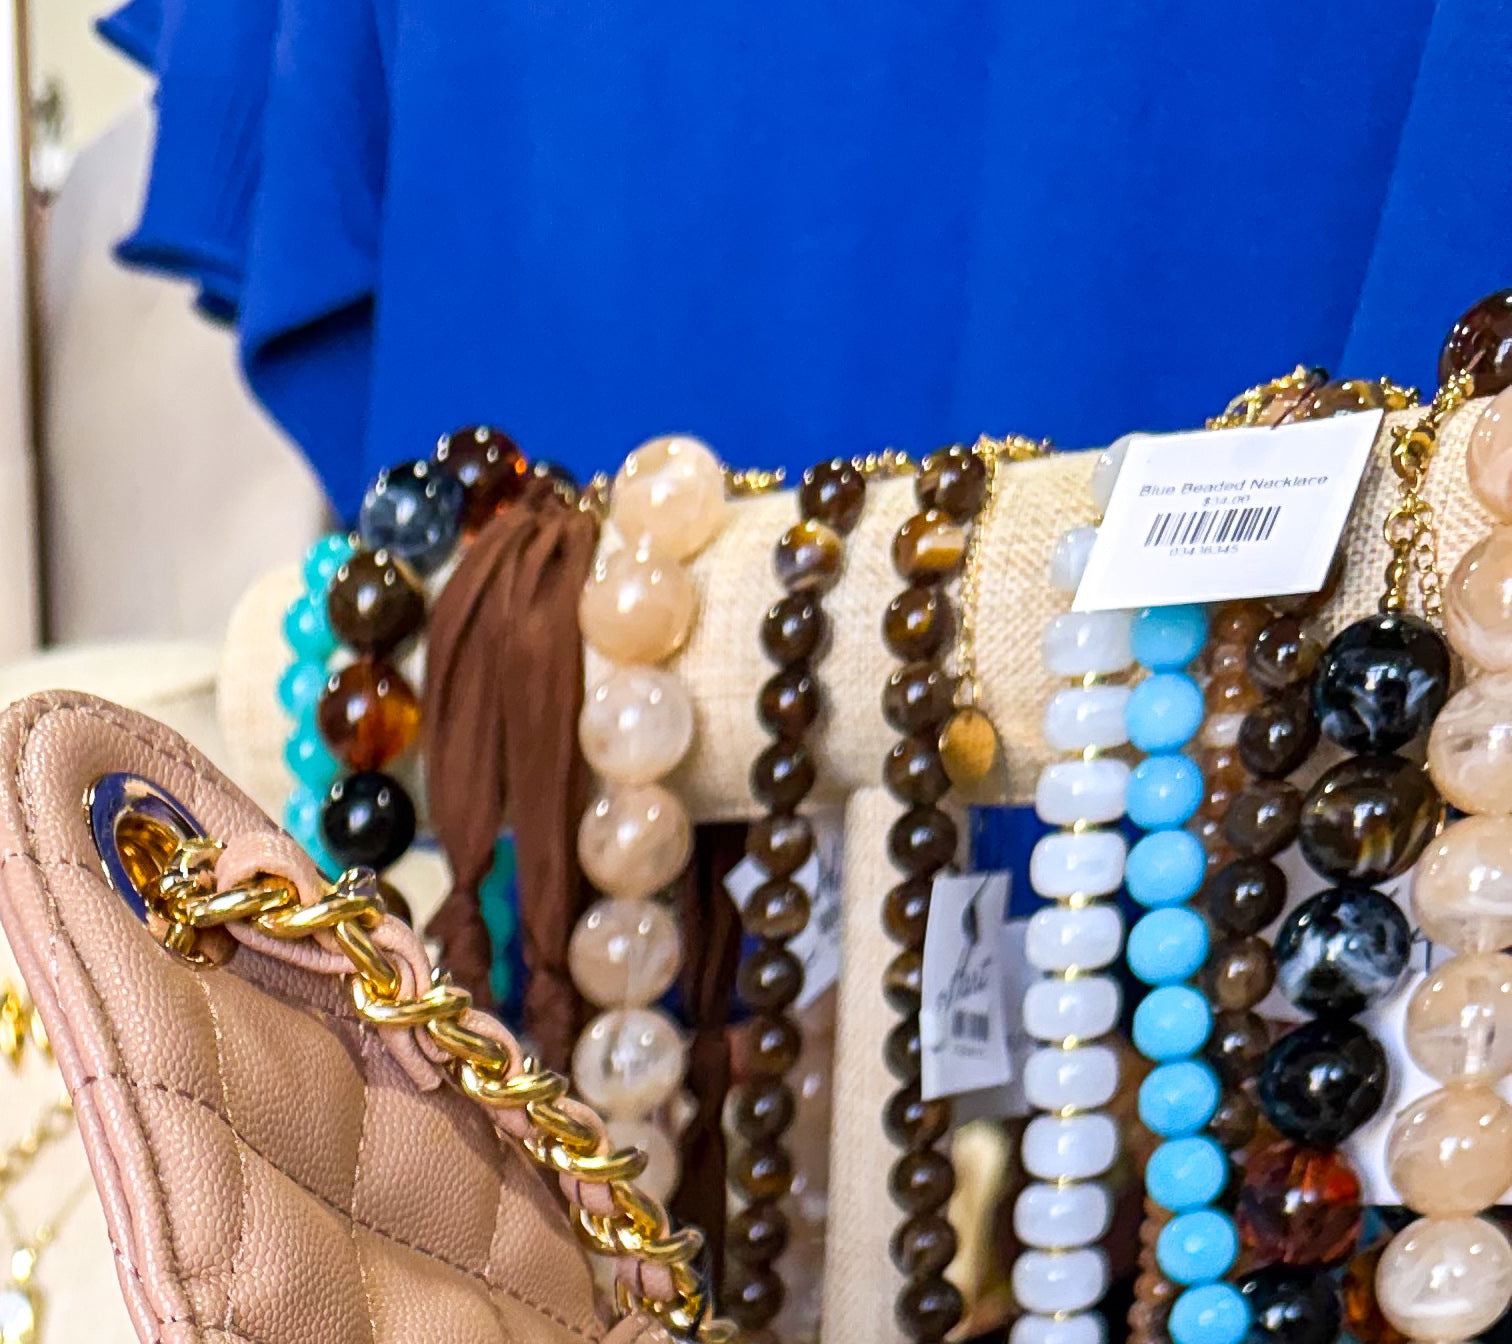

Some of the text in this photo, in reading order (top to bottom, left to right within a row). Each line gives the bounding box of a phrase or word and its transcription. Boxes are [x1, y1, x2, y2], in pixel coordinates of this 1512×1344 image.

[1139, 475, 1329, 497] Blue Beaded Necklace
